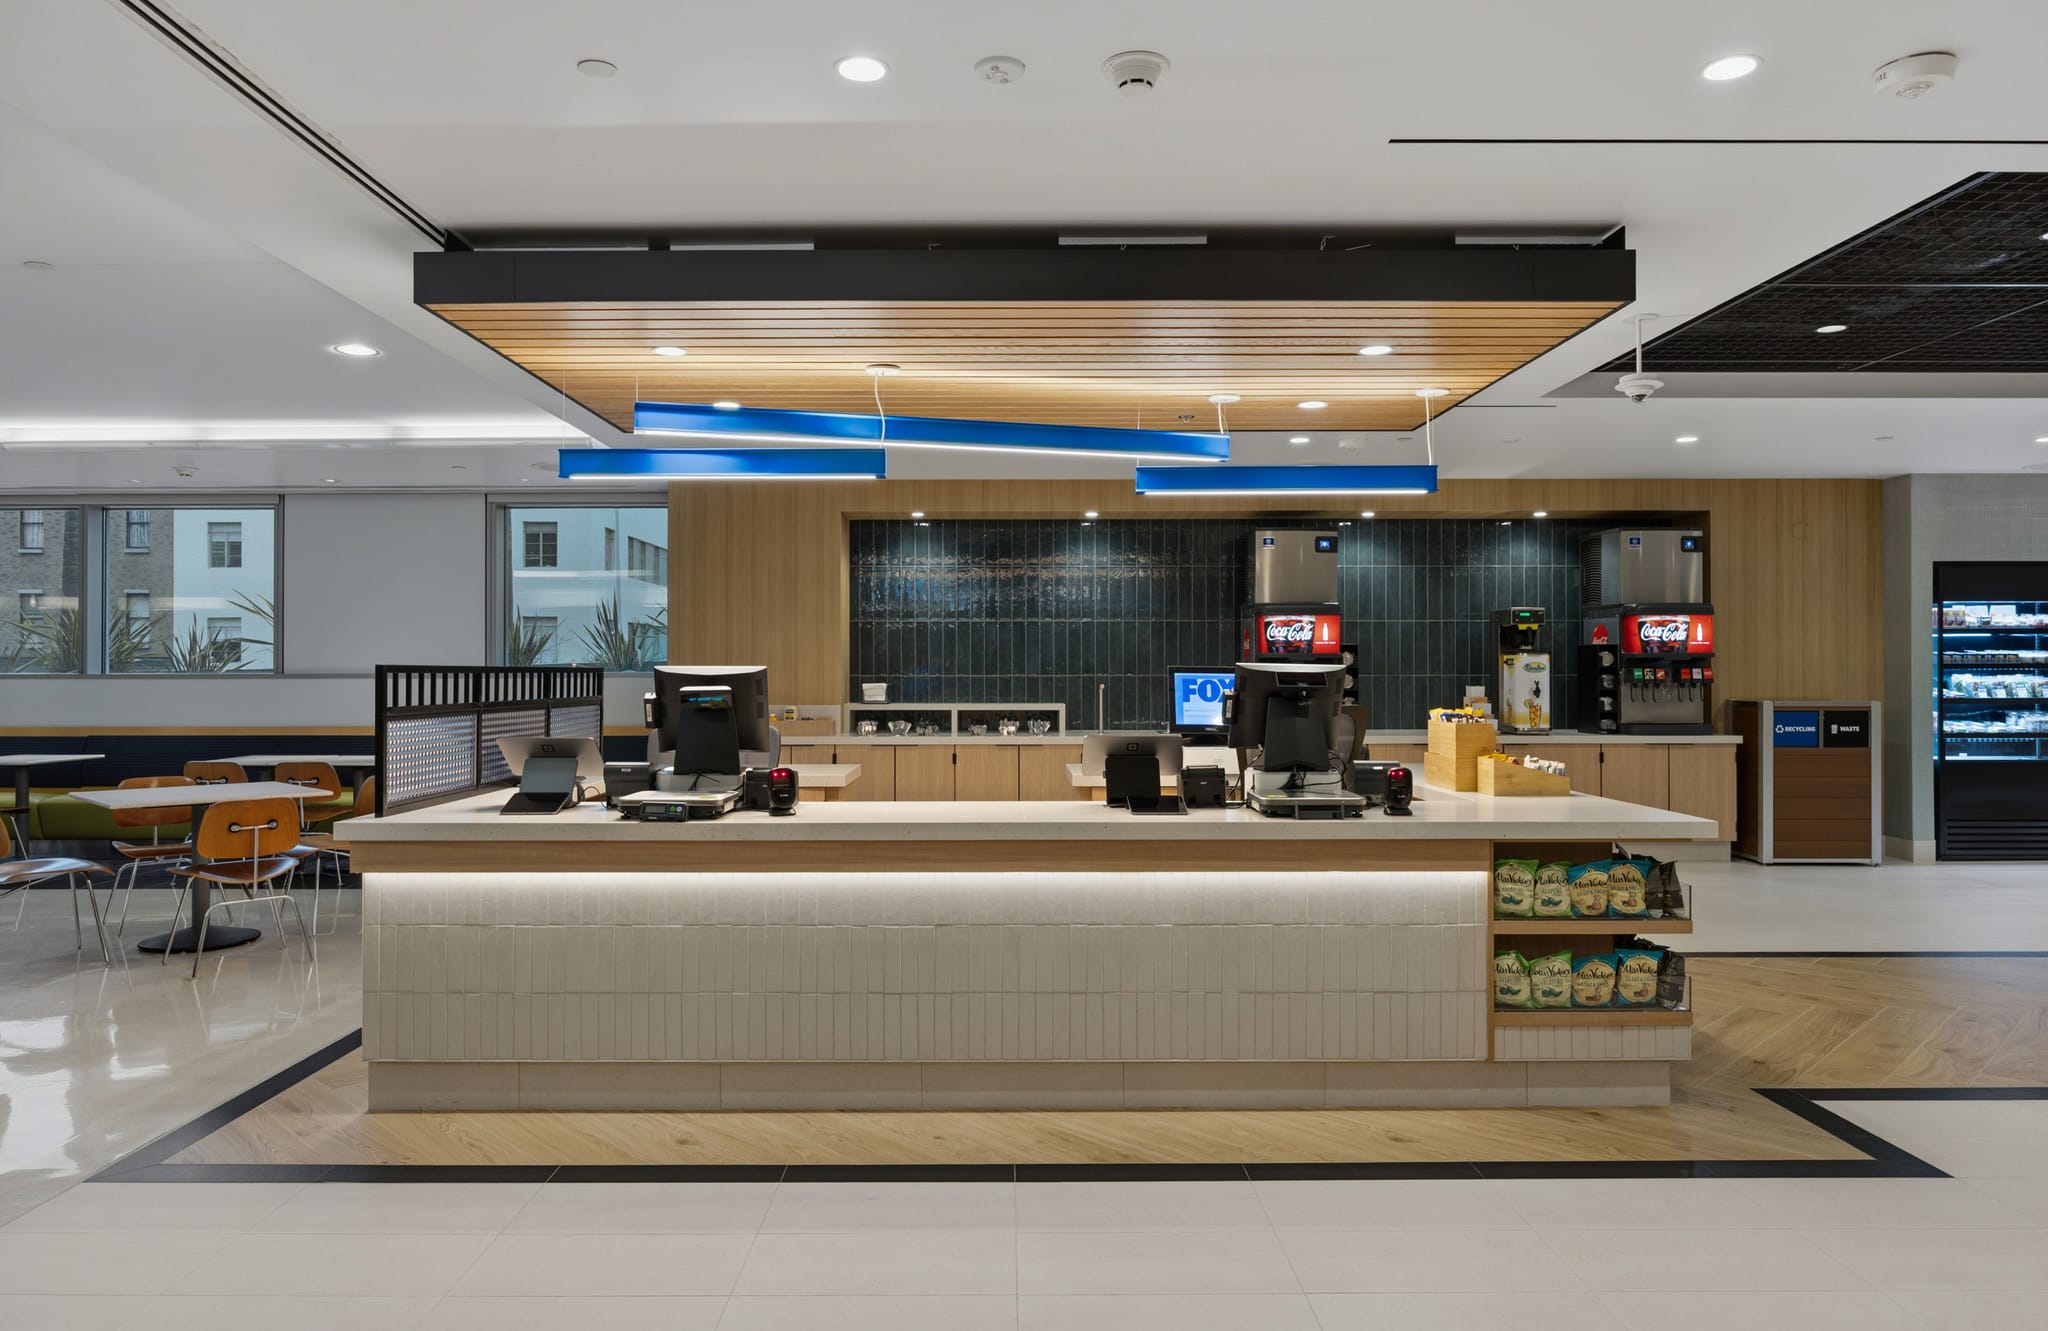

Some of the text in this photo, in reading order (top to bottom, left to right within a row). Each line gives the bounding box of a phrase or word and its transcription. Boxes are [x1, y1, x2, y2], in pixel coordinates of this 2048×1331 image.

[1267, 622, 1314, 641] Coca-Cola
[1641, 622, 1689, 641] Coca-Cola
[1183, 678, 1235, 703] FOX
